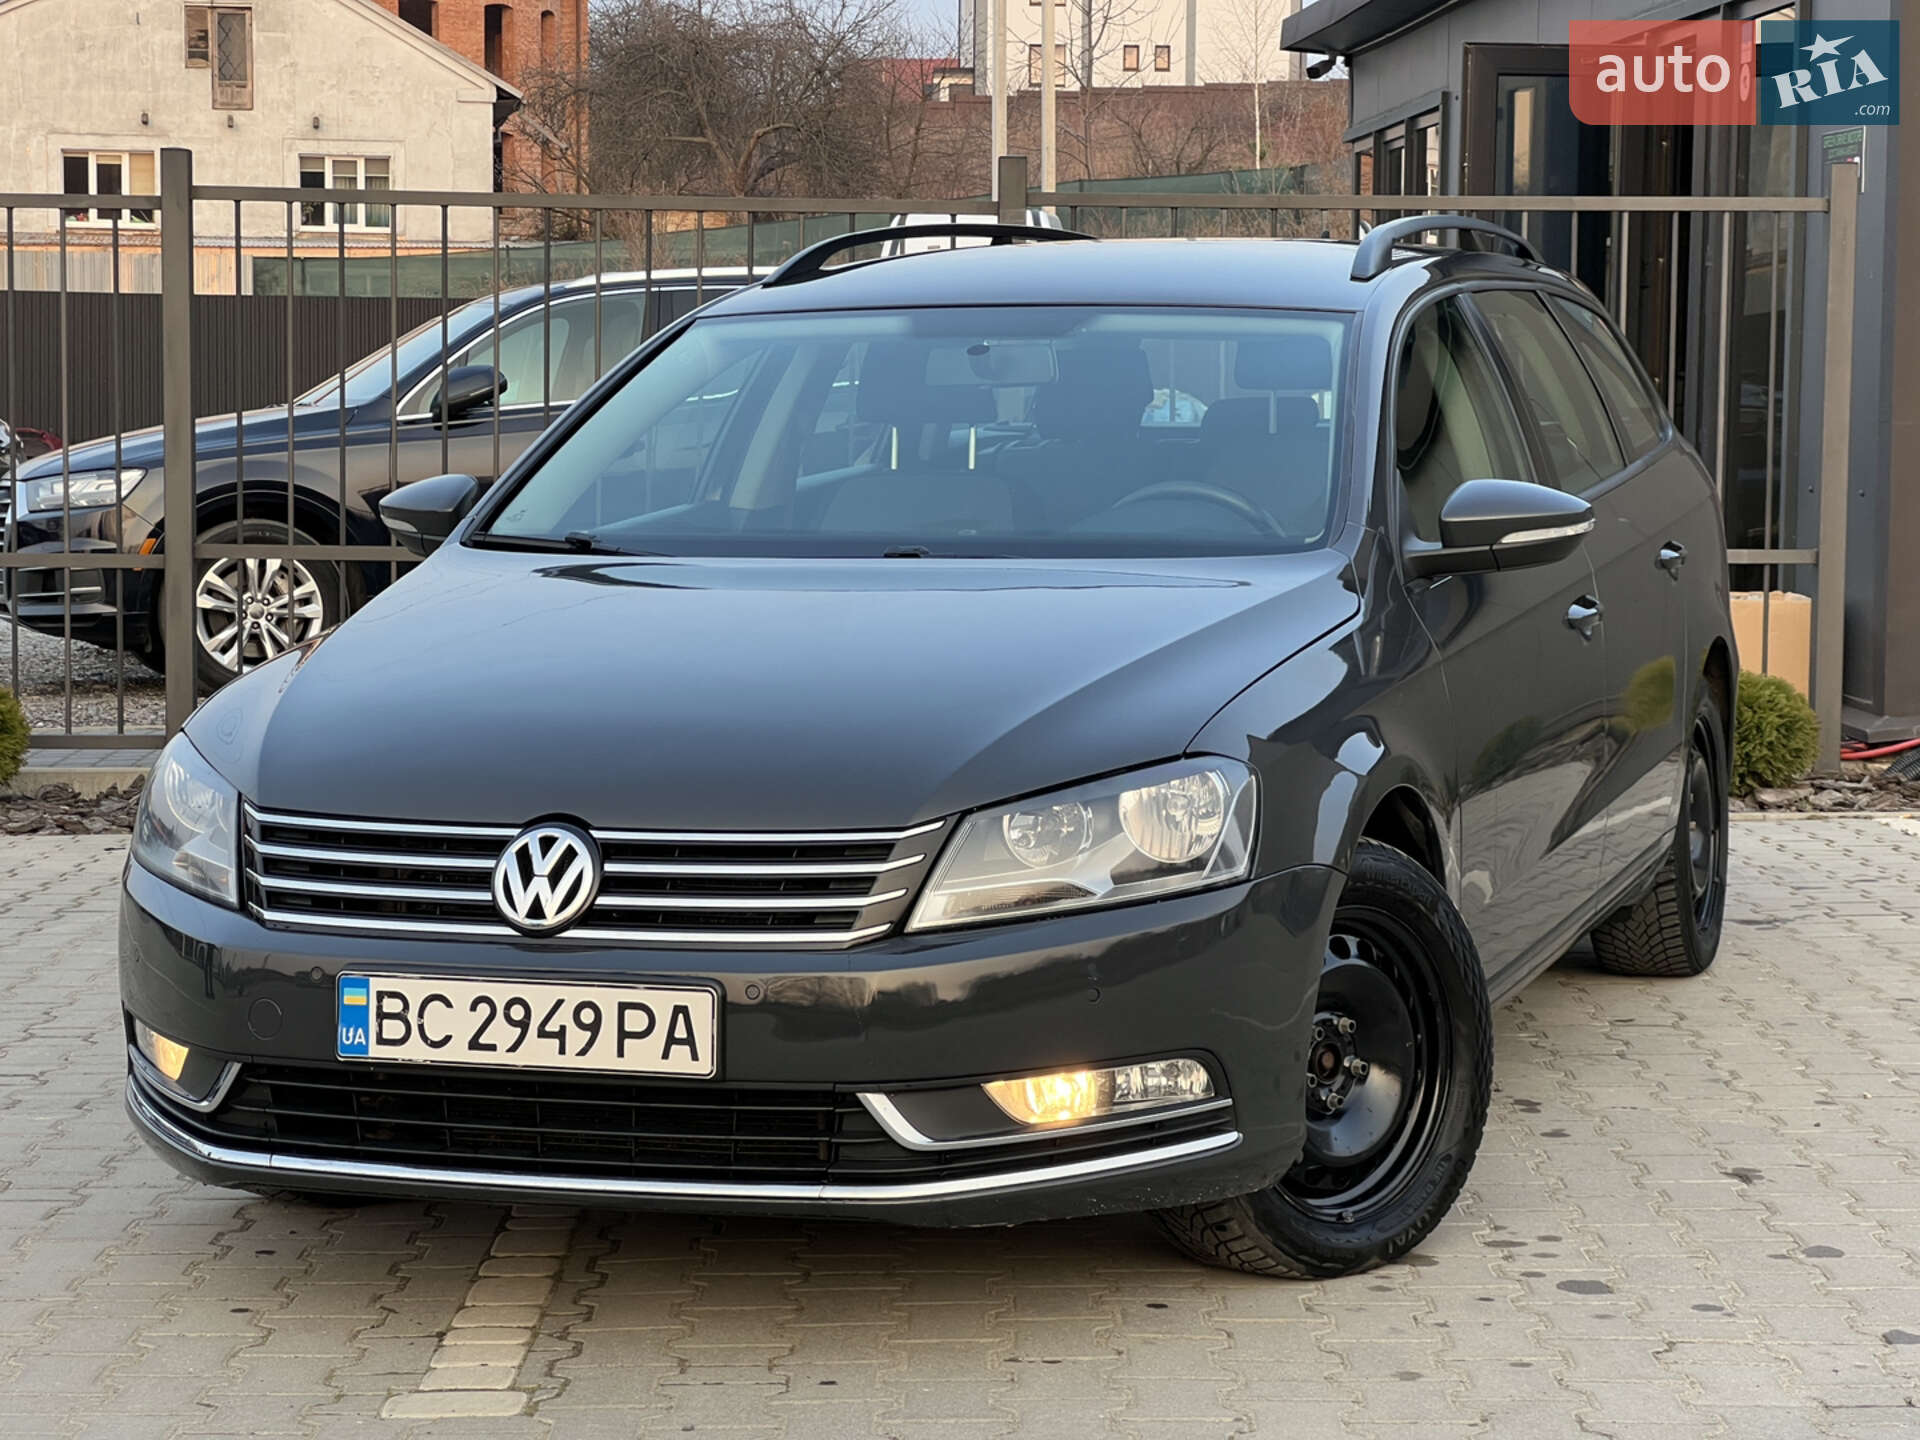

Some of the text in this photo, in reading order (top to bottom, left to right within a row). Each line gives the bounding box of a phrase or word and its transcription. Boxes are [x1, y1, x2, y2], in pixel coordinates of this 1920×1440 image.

[341, 1025, 367, 1046] UA
[375, 990, 700, 1062] BC 2949 PA
